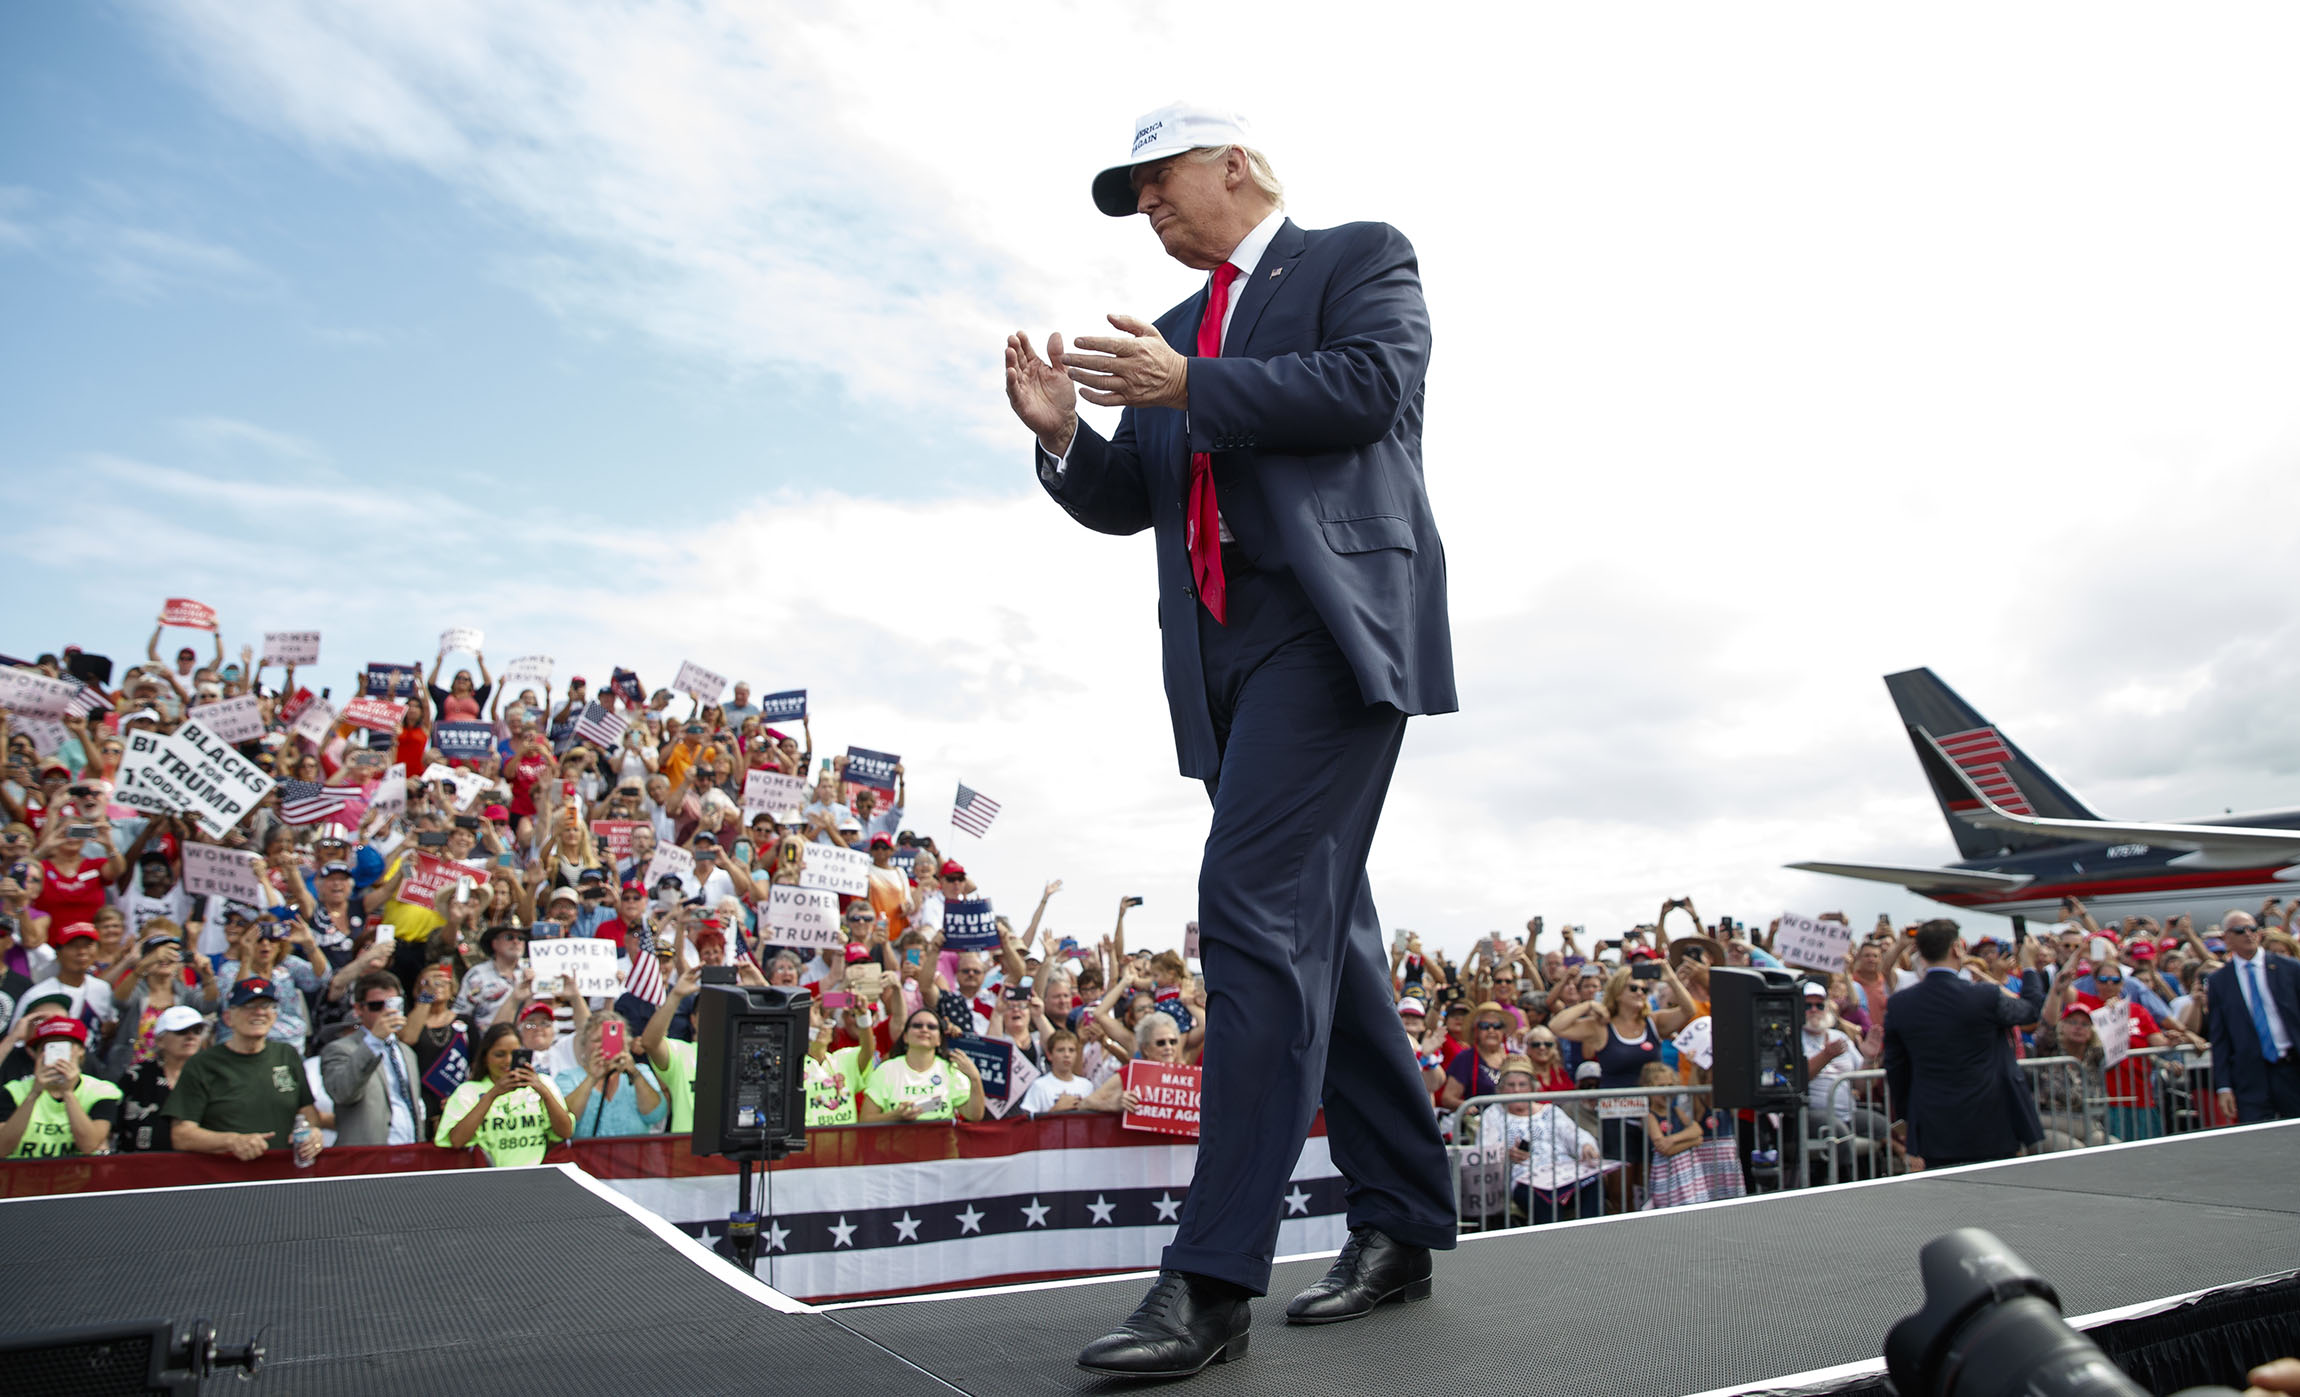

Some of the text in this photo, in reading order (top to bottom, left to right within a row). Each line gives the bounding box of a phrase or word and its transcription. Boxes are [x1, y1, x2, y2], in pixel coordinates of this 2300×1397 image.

[1133, 121, 1163, 145] MERICA
[1134, 133, 1158, 152] AGAIN
[438, 729, 492, 741] TRUMP
[182, 724, 268, 794] BLACKS
[849, 754, 897, 770] TRUMP
[197, 760, 226, 785] FOR
[157, 748, 242, 815] TRUMP
[750, 774, 806, 791] WOMEN
[185, 846, 254, 867] WOME
[806, 847, 873, 866] WOMEN
[823, 863, 848, 874] FOR
[191, 876, 258, 898] TRUMP
[807, 873, 865, 891] TRUMP
[407, 883, 436, 899] GREA
[795, 912, 822, 923] FOR
[773, 926, 839, 943] TRUMP
[1783, 916, 1852, 941] WOMEN
[533, 944, 616, 957] WOMEN
[1799, 935, 1825, 949] FOR
[1780, 943, 1846, 968] TRUMP
[561, 961, 591, 971] FOR
[576, 978, 615, 991] UMP
[1161, 1072, 1196, 1088] MAKE
[903, 1085, 935, 1096] TEXT
[1132, 1084, 1201, 1110] AMERIC
[1134, 1103, 1201, 1123] GREAT AGA
[481, 1114, 546, 1133] TRUMP
[20, 1141, 76, 1158] RUM
